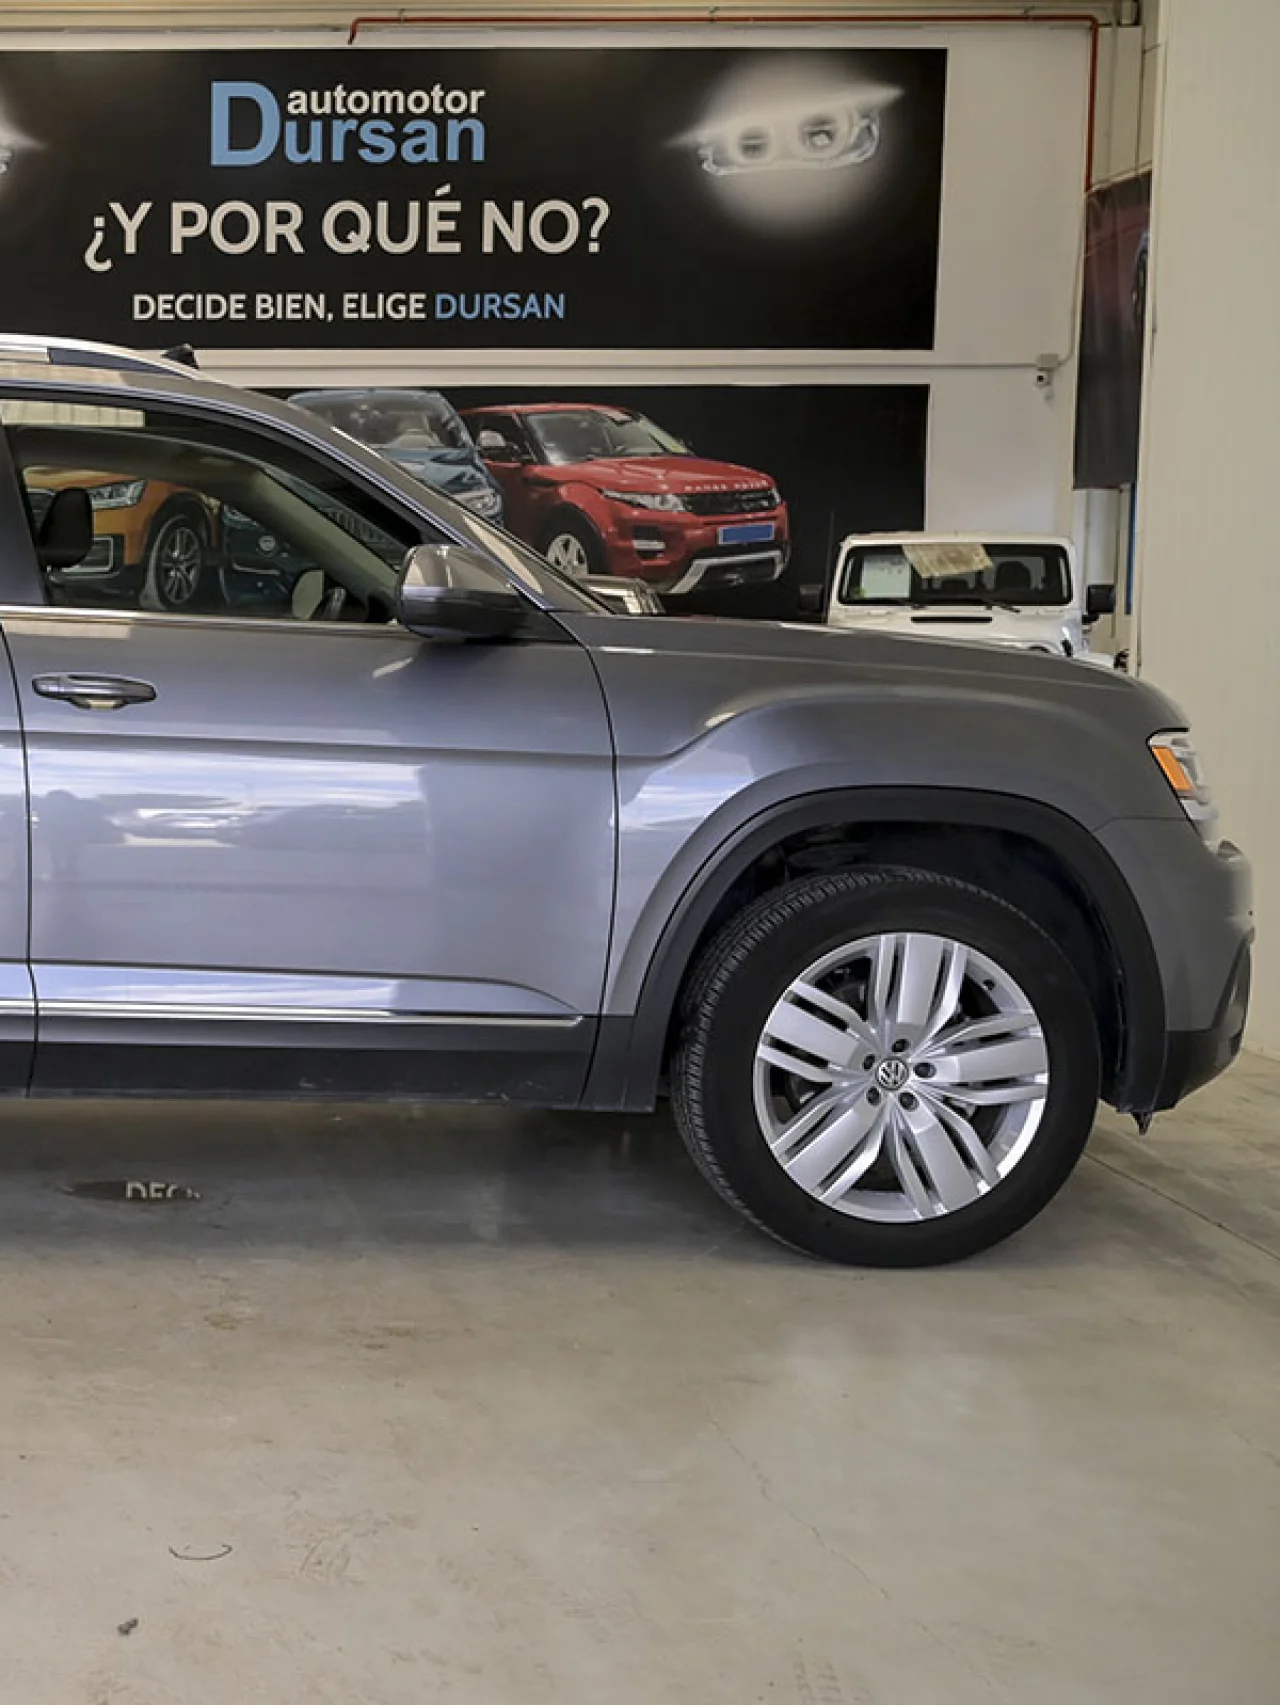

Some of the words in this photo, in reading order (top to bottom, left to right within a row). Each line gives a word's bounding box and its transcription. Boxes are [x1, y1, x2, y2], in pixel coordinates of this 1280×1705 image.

[211, 81, 485, 167] Dursan
[288, 83, 485, 114] automotor
[85, 201, 152, 272] ¿Y
[170, 201, 305, 254] POR
[322, 184, 461, 254] QUÉ
[482, 197, 610, 254] NO?
[133, 294, 246, 320] DECIDE
[255, 294, 333, 323] BIEN,
[343, 293, 426, 319] ELIGE
[435, 293, 565, 319] DURSAN
